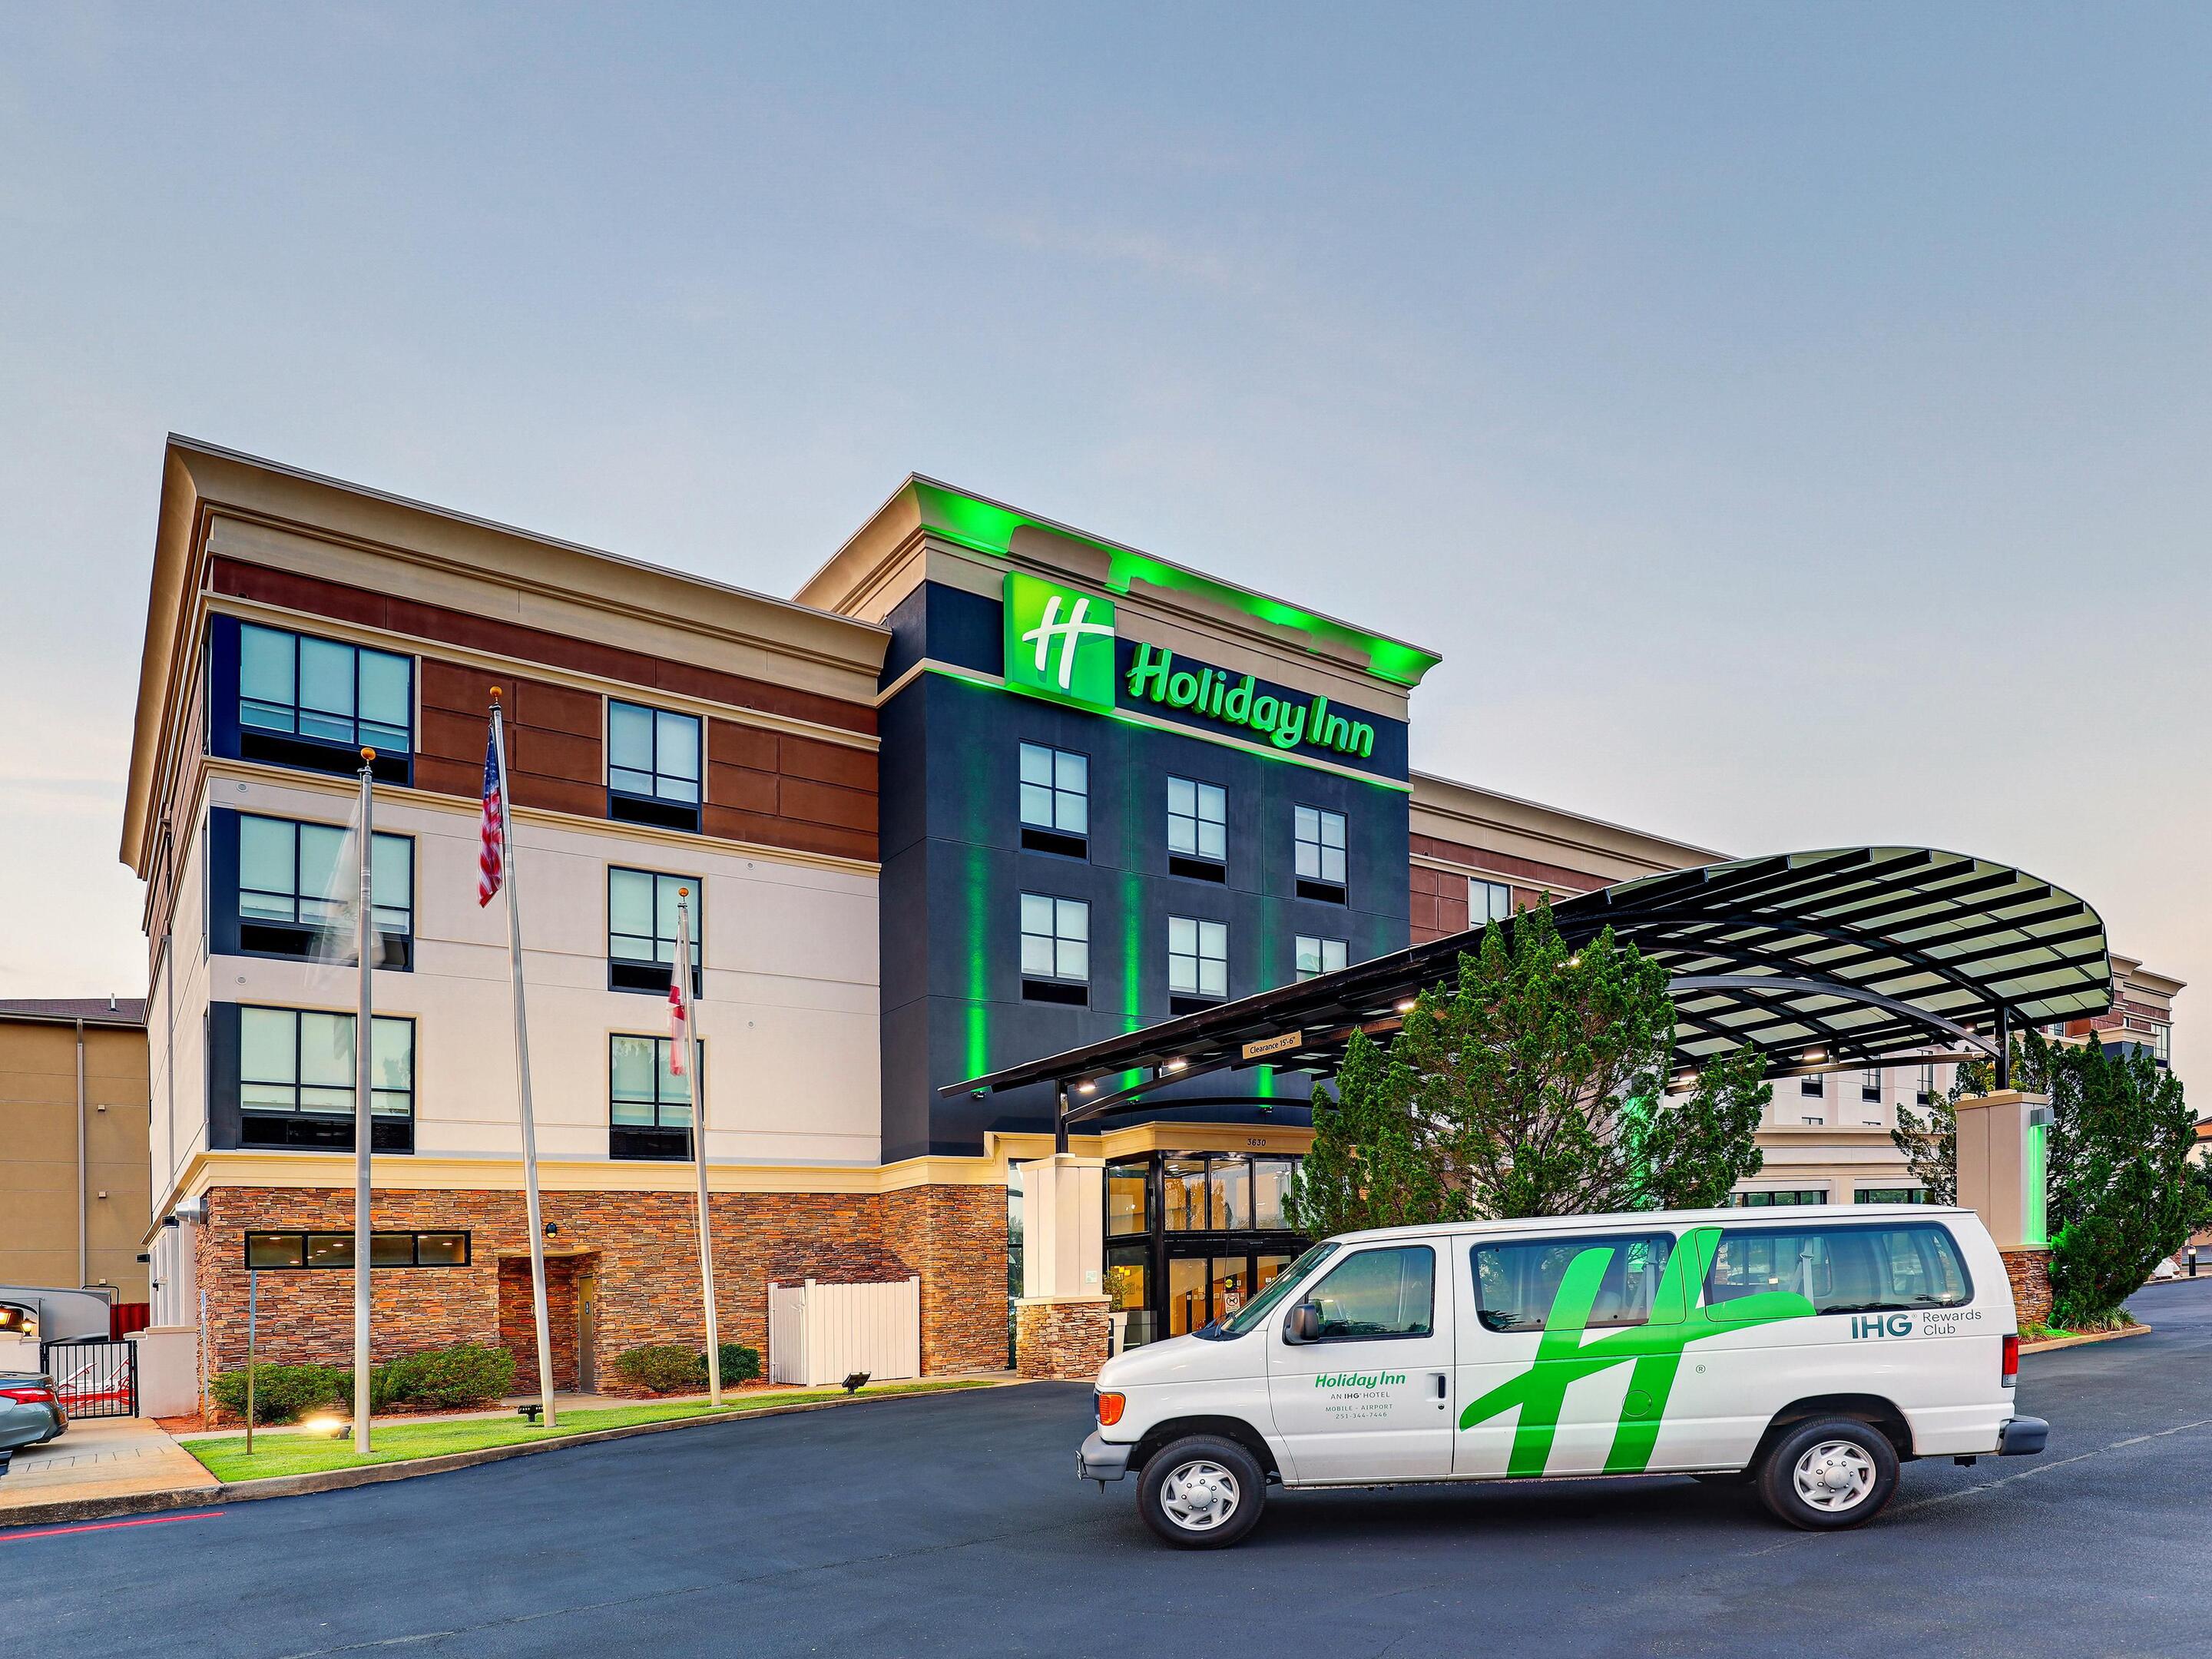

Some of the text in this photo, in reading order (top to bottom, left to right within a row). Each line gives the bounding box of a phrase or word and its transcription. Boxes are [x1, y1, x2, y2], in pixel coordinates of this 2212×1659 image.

[1125, 642, 1374, 759] Holiday Inn
[1250, 1041, 1279, 1054] Clearance
[1247, 1138, 1267, 1147] 3630
[1922, 1309, 1982, 1323] Rewards
[1923, 1323, 1956, 1336] Club
[1315, 1371, 1406, 1389] Holiday Inn
